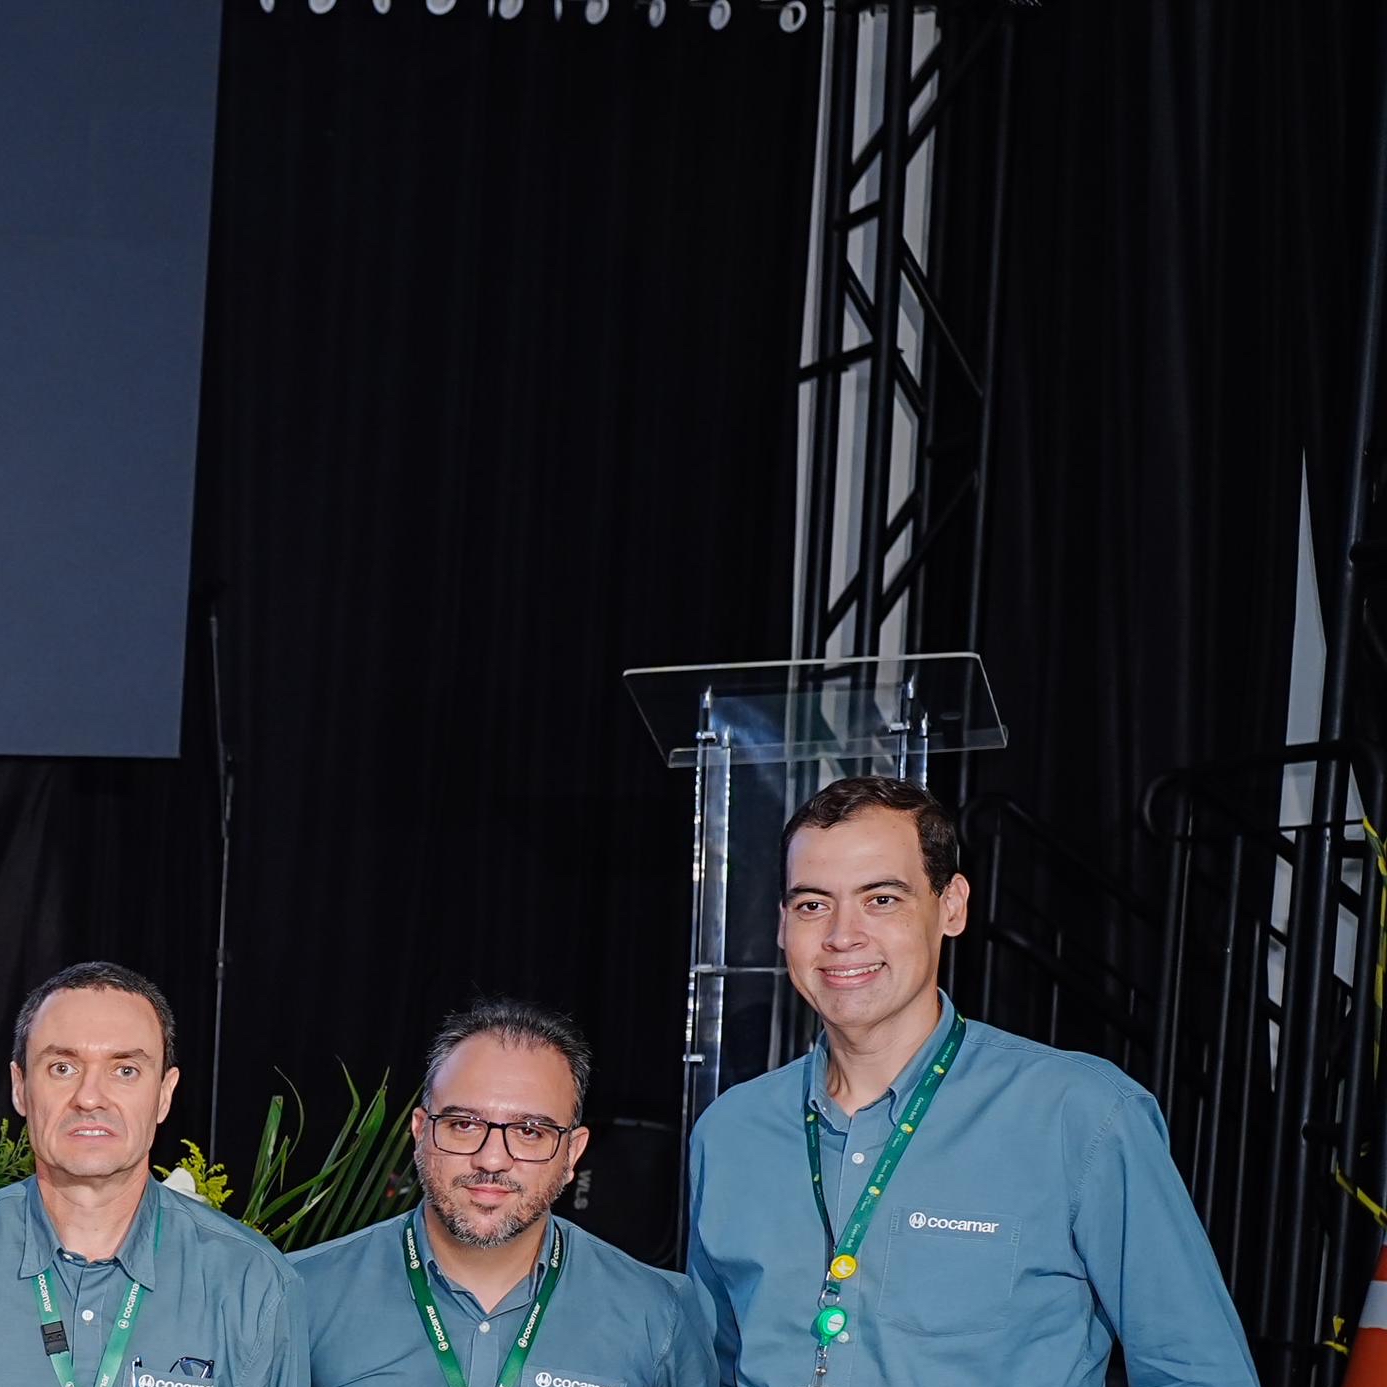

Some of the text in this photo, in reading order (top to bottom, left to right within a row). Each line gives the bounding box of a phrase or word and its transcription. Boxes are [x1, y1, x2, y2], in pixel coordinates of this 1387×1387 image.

[928, 1216, 999, 1234] cocamar
[38, 1274, 52, 1313] cocamar
[123, 1281, 141, 1319] cocama
[426, 1305, 445, 1342] cocamar
[523, 1302, 541, 1340] cocamar
